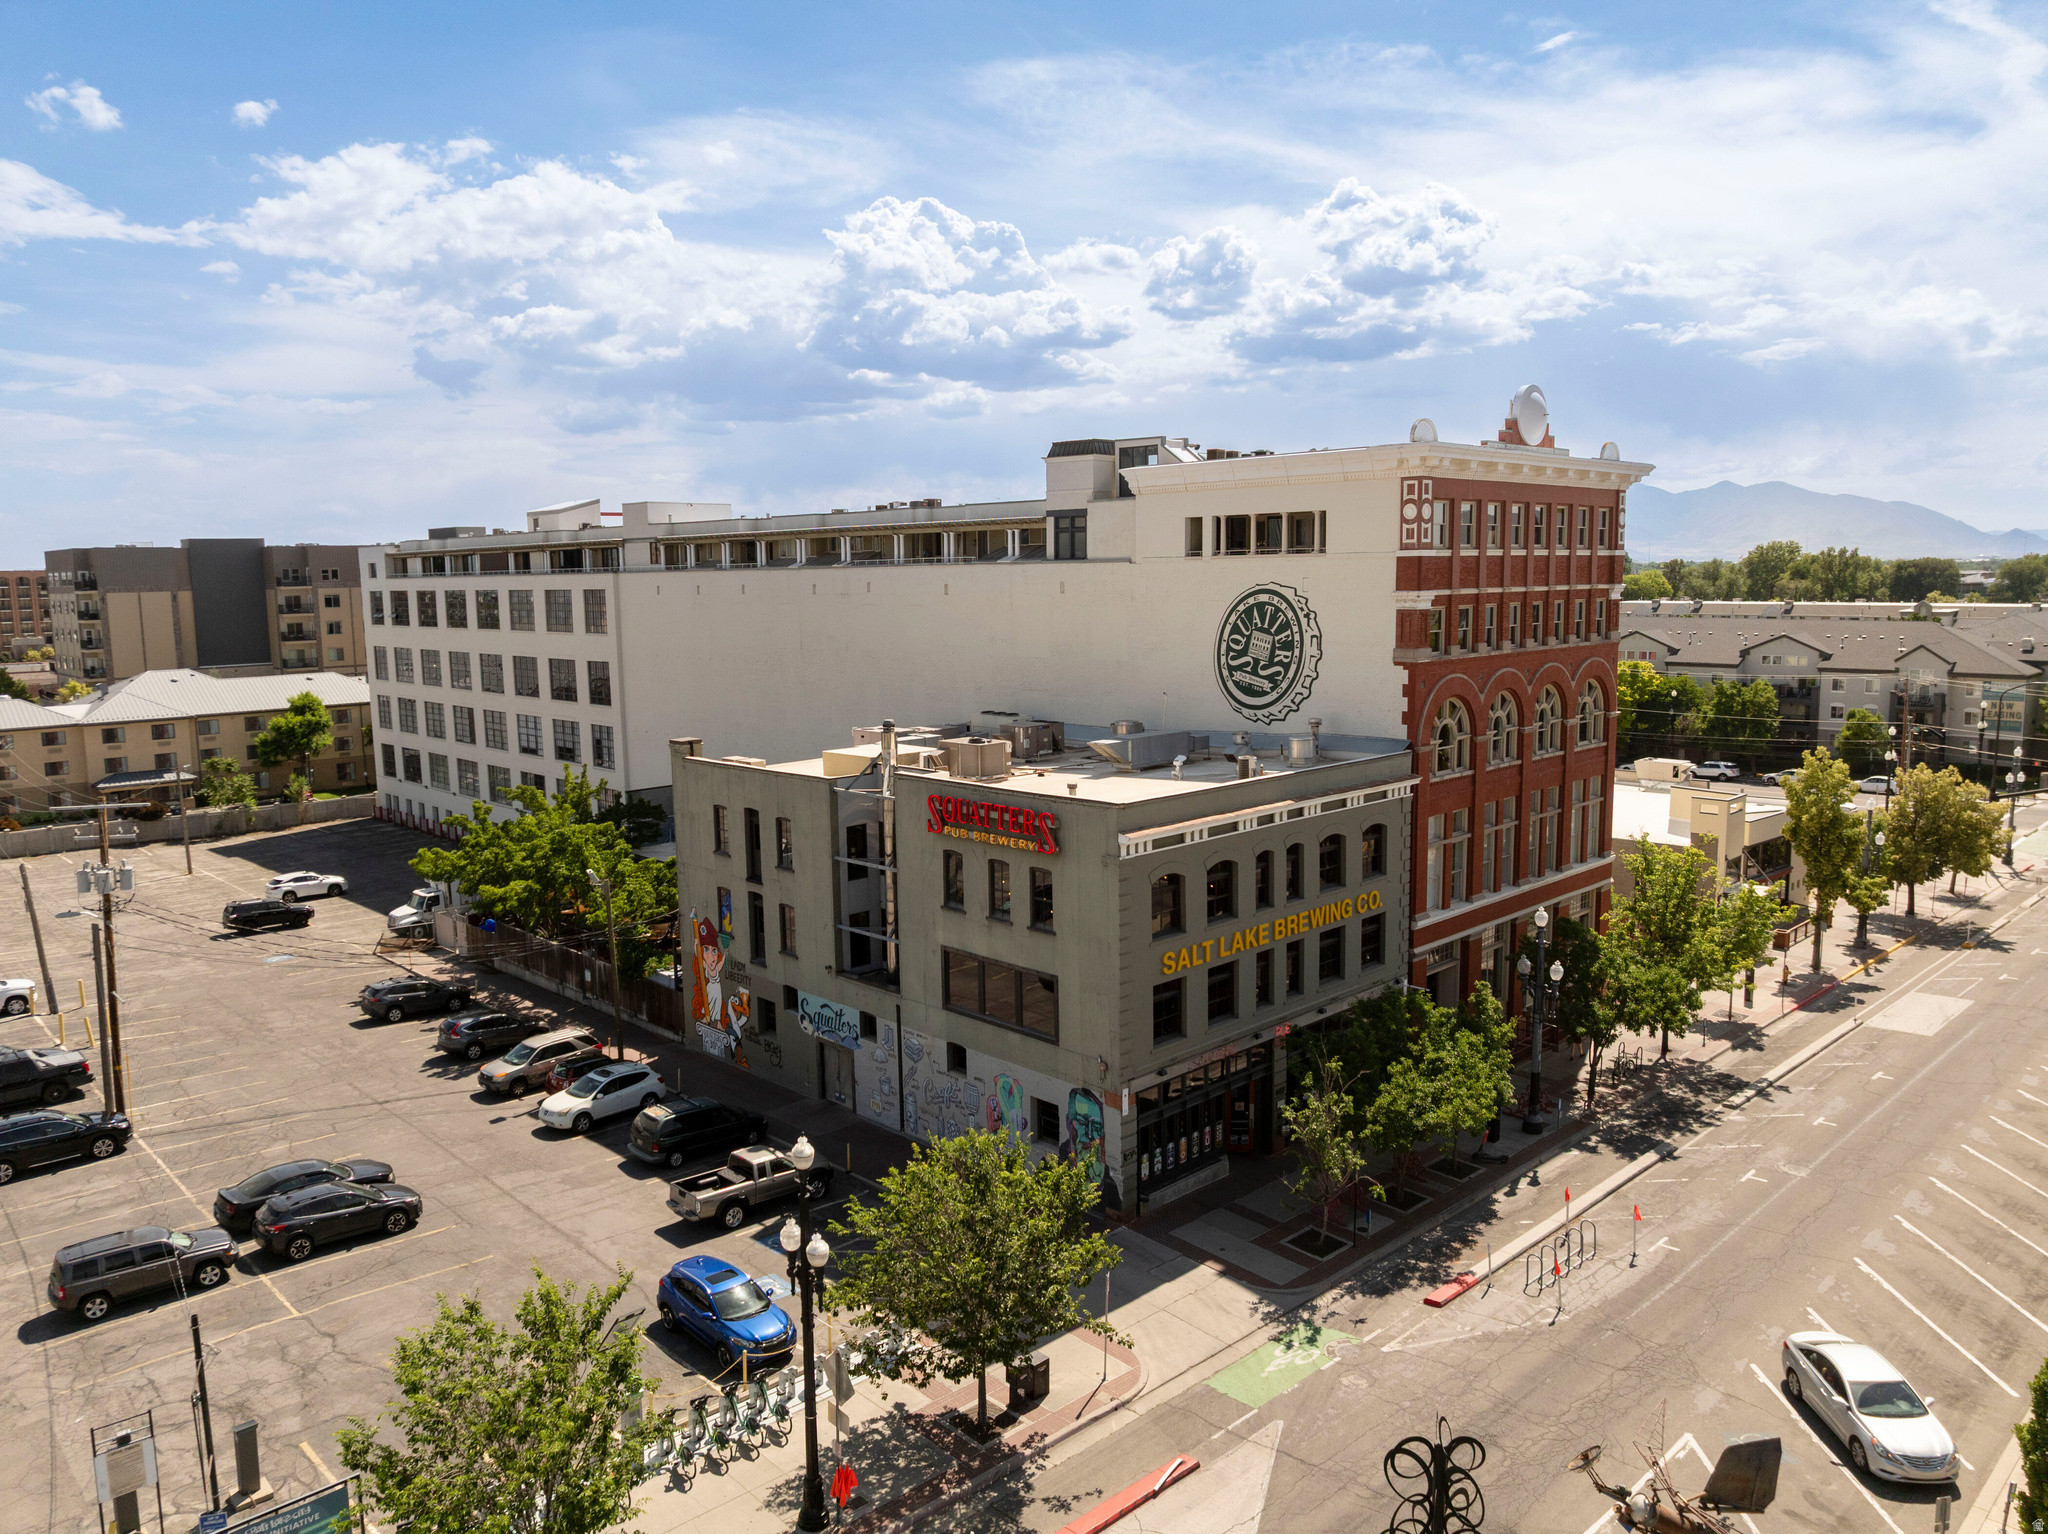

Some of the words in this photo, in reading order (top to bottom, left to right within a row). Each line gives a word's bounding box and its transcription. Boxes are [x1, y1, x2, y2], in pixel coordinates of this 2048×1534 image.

[1228, 595, 1261, 626] LAKE
[1268, 595, 1300, 665] BREWING
[1228, 605, 1292, 681] SQUATTERS
[1991, 702, 2014, 710] NOW
[928, 794, 1056, 855] SQUATTERS
[944, 825, 969, 839] PUB
[973, 831, 1037, 851] BREWERY
[1162, 940, 1214, 975] SALT
[1219, 923, 1269, 958] LAKE
[1273, 898, 1352, 941] BREWING
[1356, 890, 1383, 914] CO.
[730, 959, 746, 973] LADY
[800, 997, 859, 1041] Squatters
[922, 1077, 961, 1109] Craft
[269, 1512, 320, 1534] INITIATIVE
